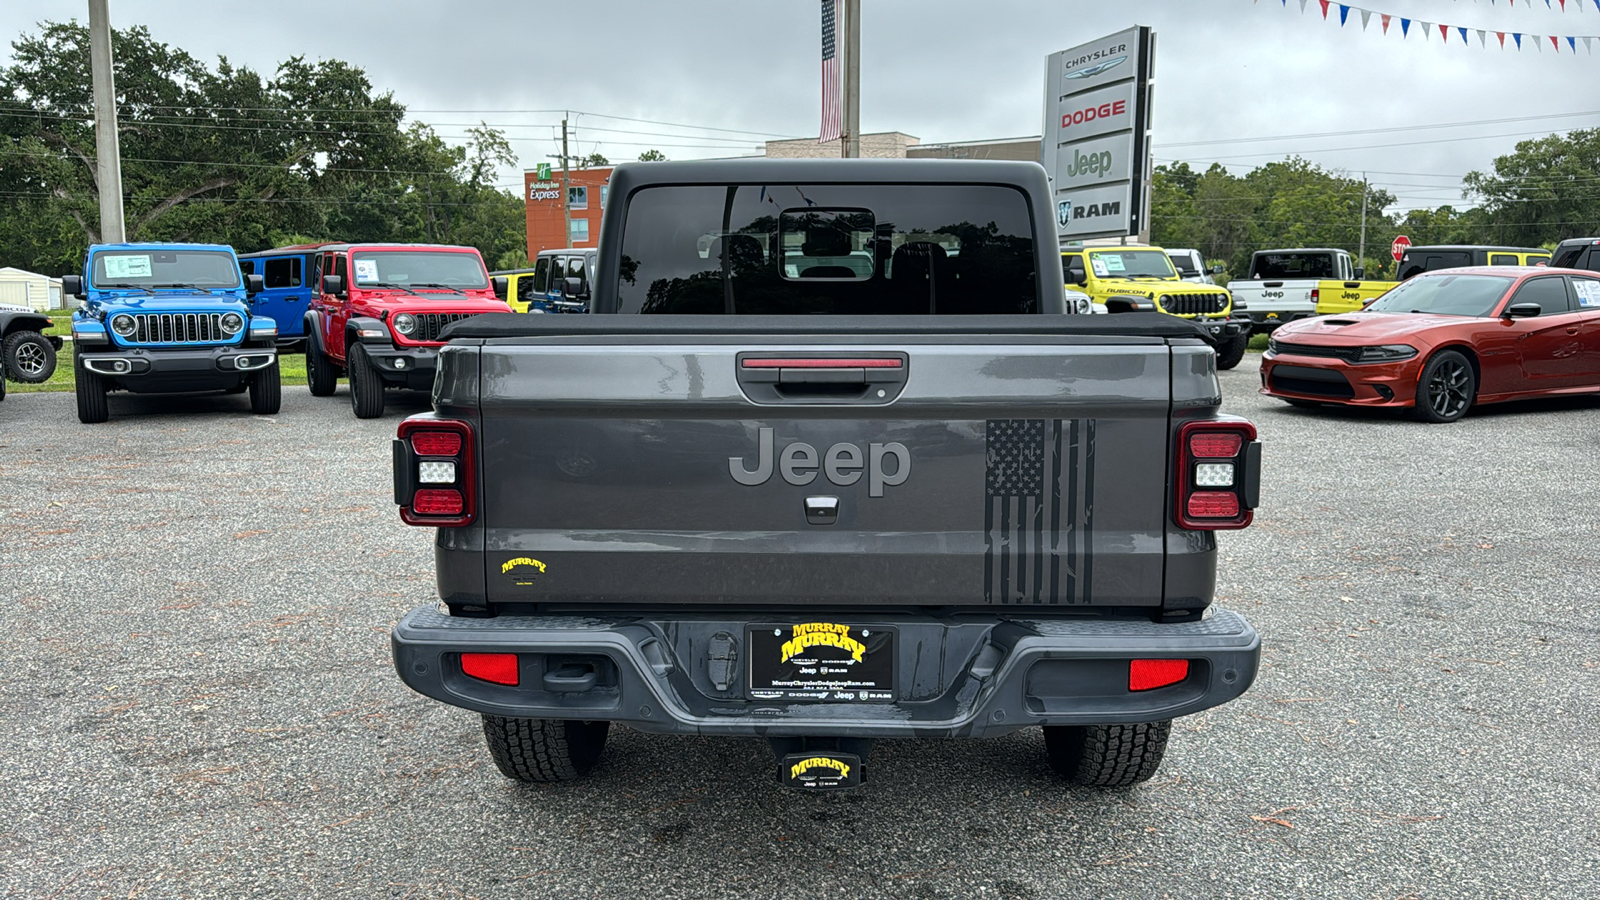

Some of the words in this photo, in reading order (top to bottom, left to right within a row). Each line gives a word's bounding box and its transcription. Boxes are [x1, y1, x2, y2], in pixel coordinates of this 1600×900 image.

[1065, 44, 1126, 69] CHRYSLER
[1061, 100, 1126, 128] DODGE
[1067, 149, 1112, 178] Jeep
[529, 182, 550, 190] Holiday
[550, 181, 560, 189] Inn
[530, 189, 560, 202] Express
[1073, 201, 1121, 219] RAM
[1261, 290, 1284, 299] Jeep
[1341, 291, 1360, 300] Jeep
[728, 427, 912, 498] Jeep
[501, 557, 547, 574] MURRAY
[792, 622, 850, 637] MURRAY
[781, 632, 866, 664] MURRAY
[799, 666, 817, 675] Jeep
[834, 691, 855, 700] Jeep
[791, 757, 850, 780] MURRAY
